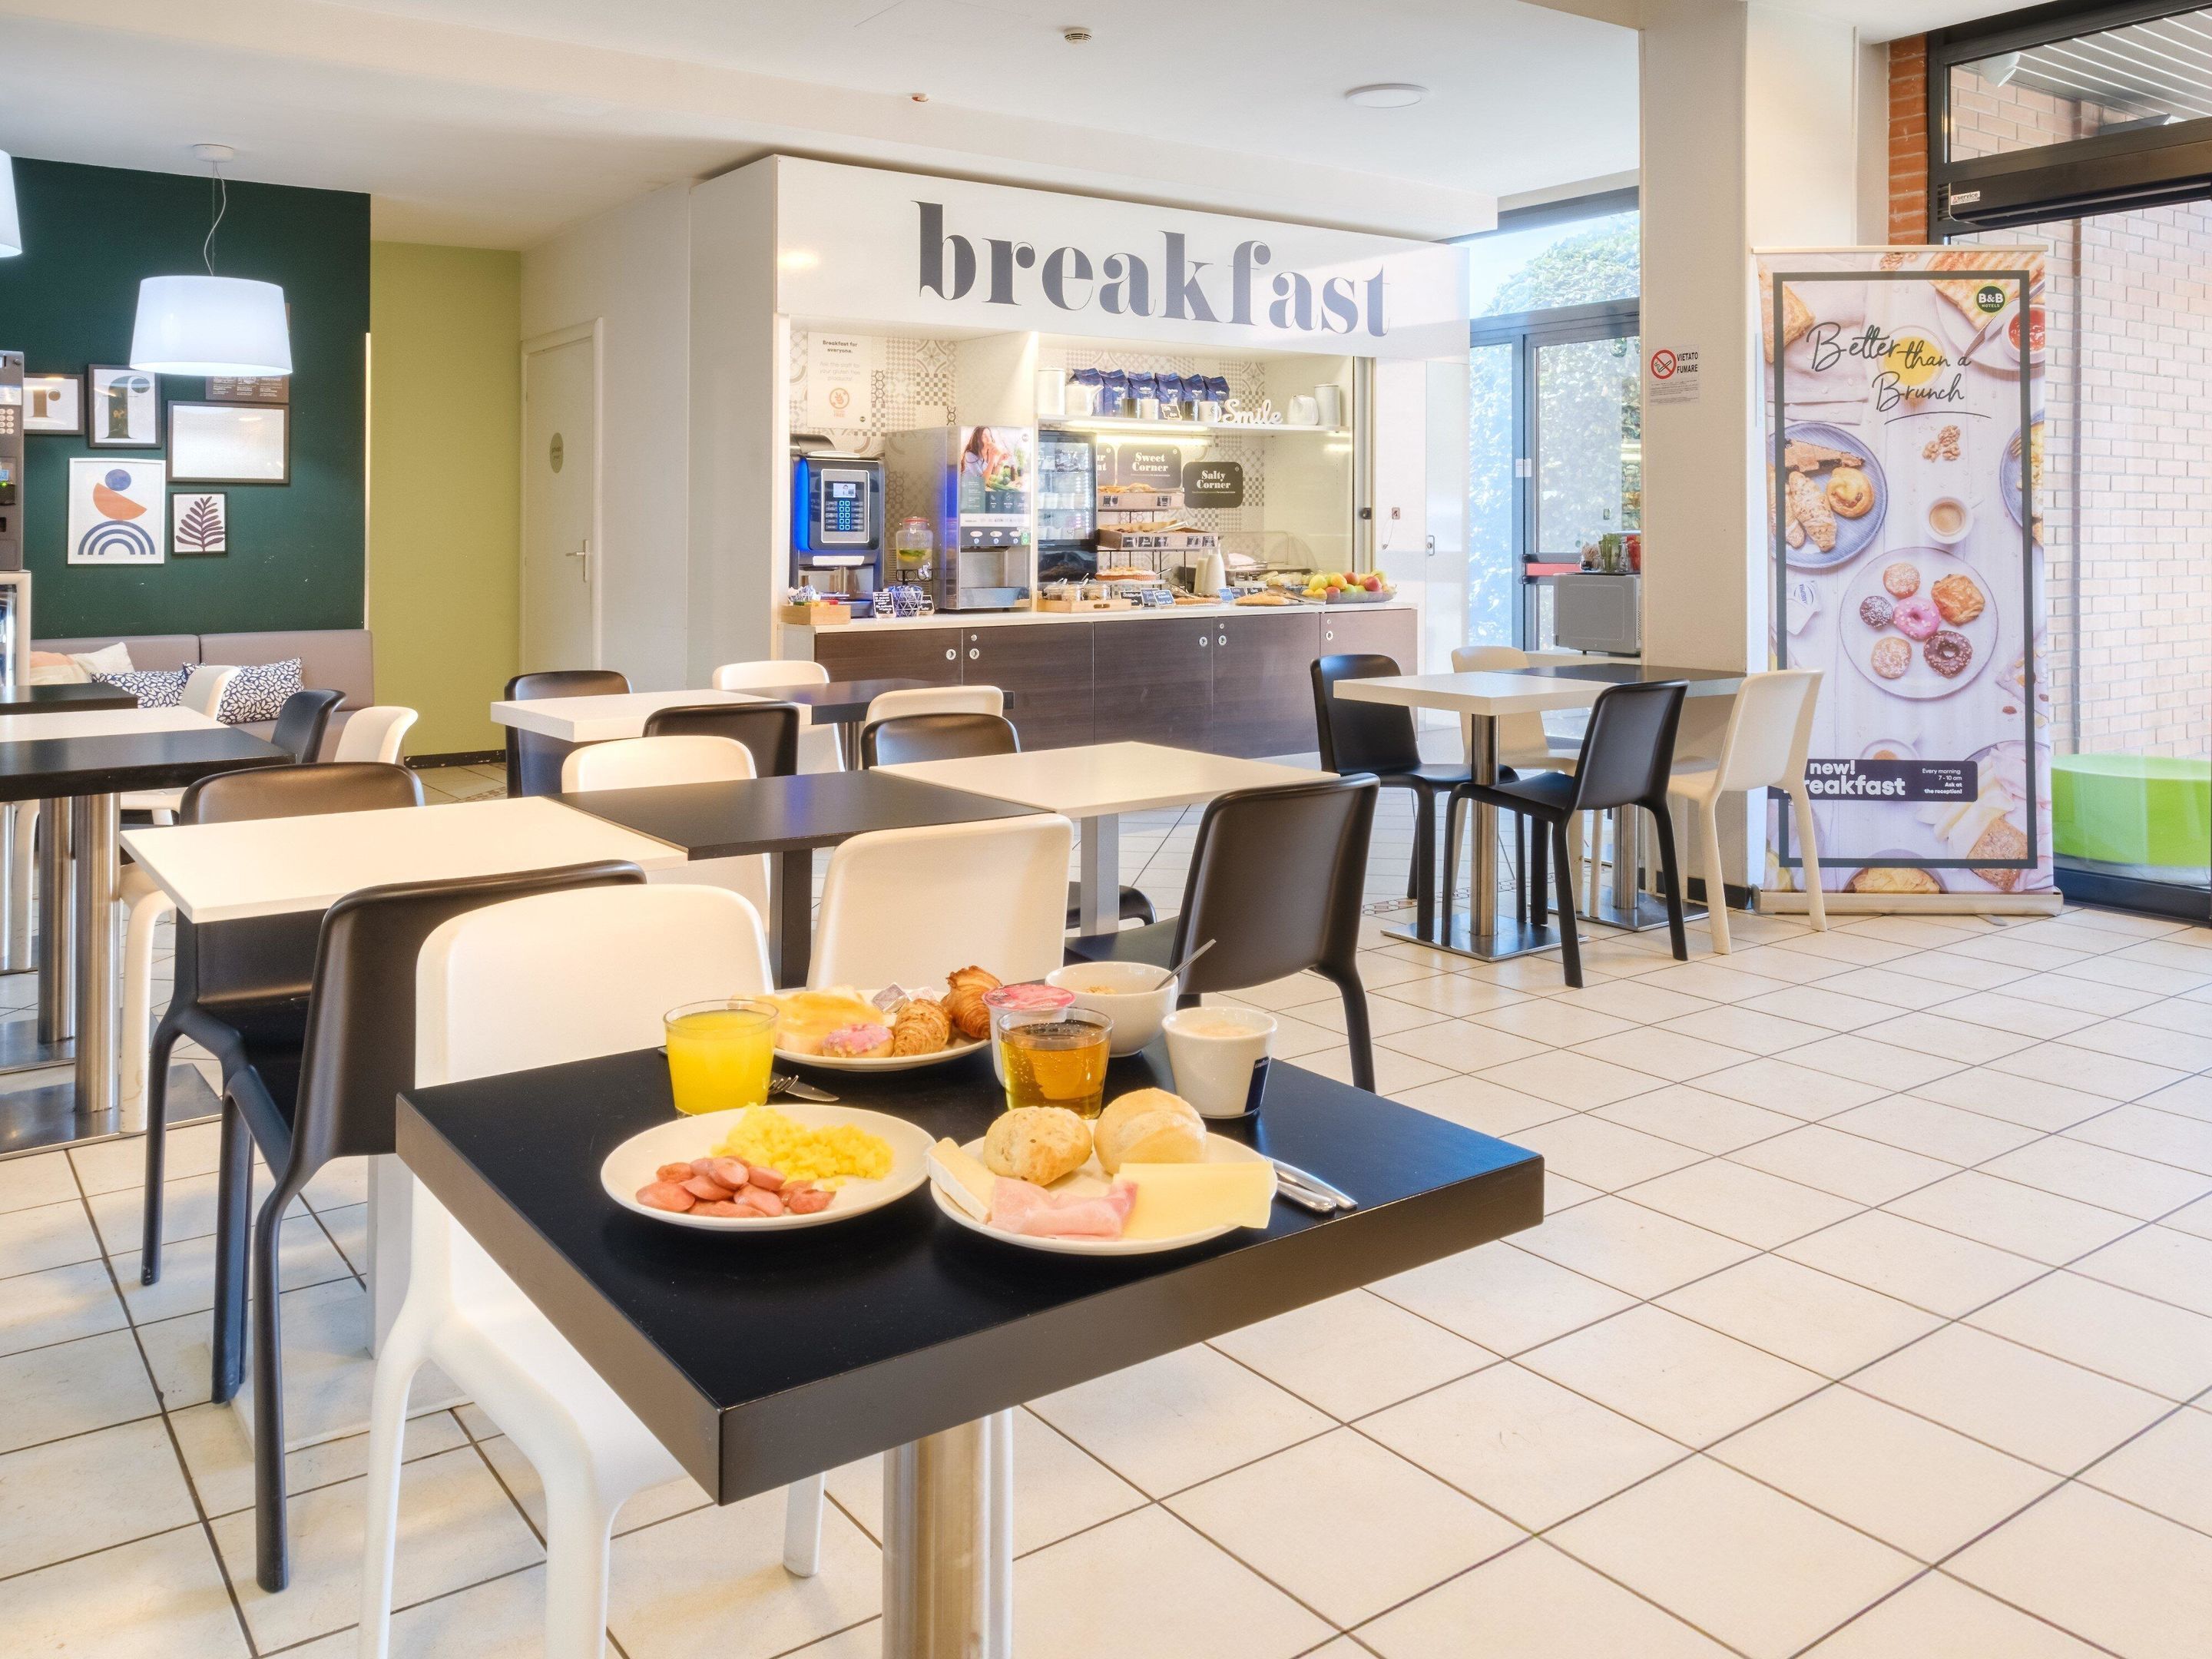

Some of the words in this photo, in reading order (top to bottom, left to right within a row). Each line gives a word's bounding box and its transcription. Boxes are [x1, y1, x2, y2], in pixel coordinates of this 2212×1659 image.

[911, 200, 1391, 337] breakfast
[1979, 293, 2003, 303] B&B
[1806, 321, 1900, 372] Better
[1896, 339, 1951, 369] than
[1958, 356, 1972, 367] a
[1677, 352, 1698, 361] VIETATO
[1677, 364, 1698, 373] FUMARE
[1872, 371, 1965, 412] Brunch
[1221, 399, 1283, 424] Smile
[1135, 452, 1165, 462] Sweet
[1132, 462, 1168, 472] Corner
[1201, 470, 1226, 482] Salty
[1196, 479, 1231, 489] Corner
[1810, 760, 1856, 775] new!
[1783, 775, 1906, 796] eakfast
